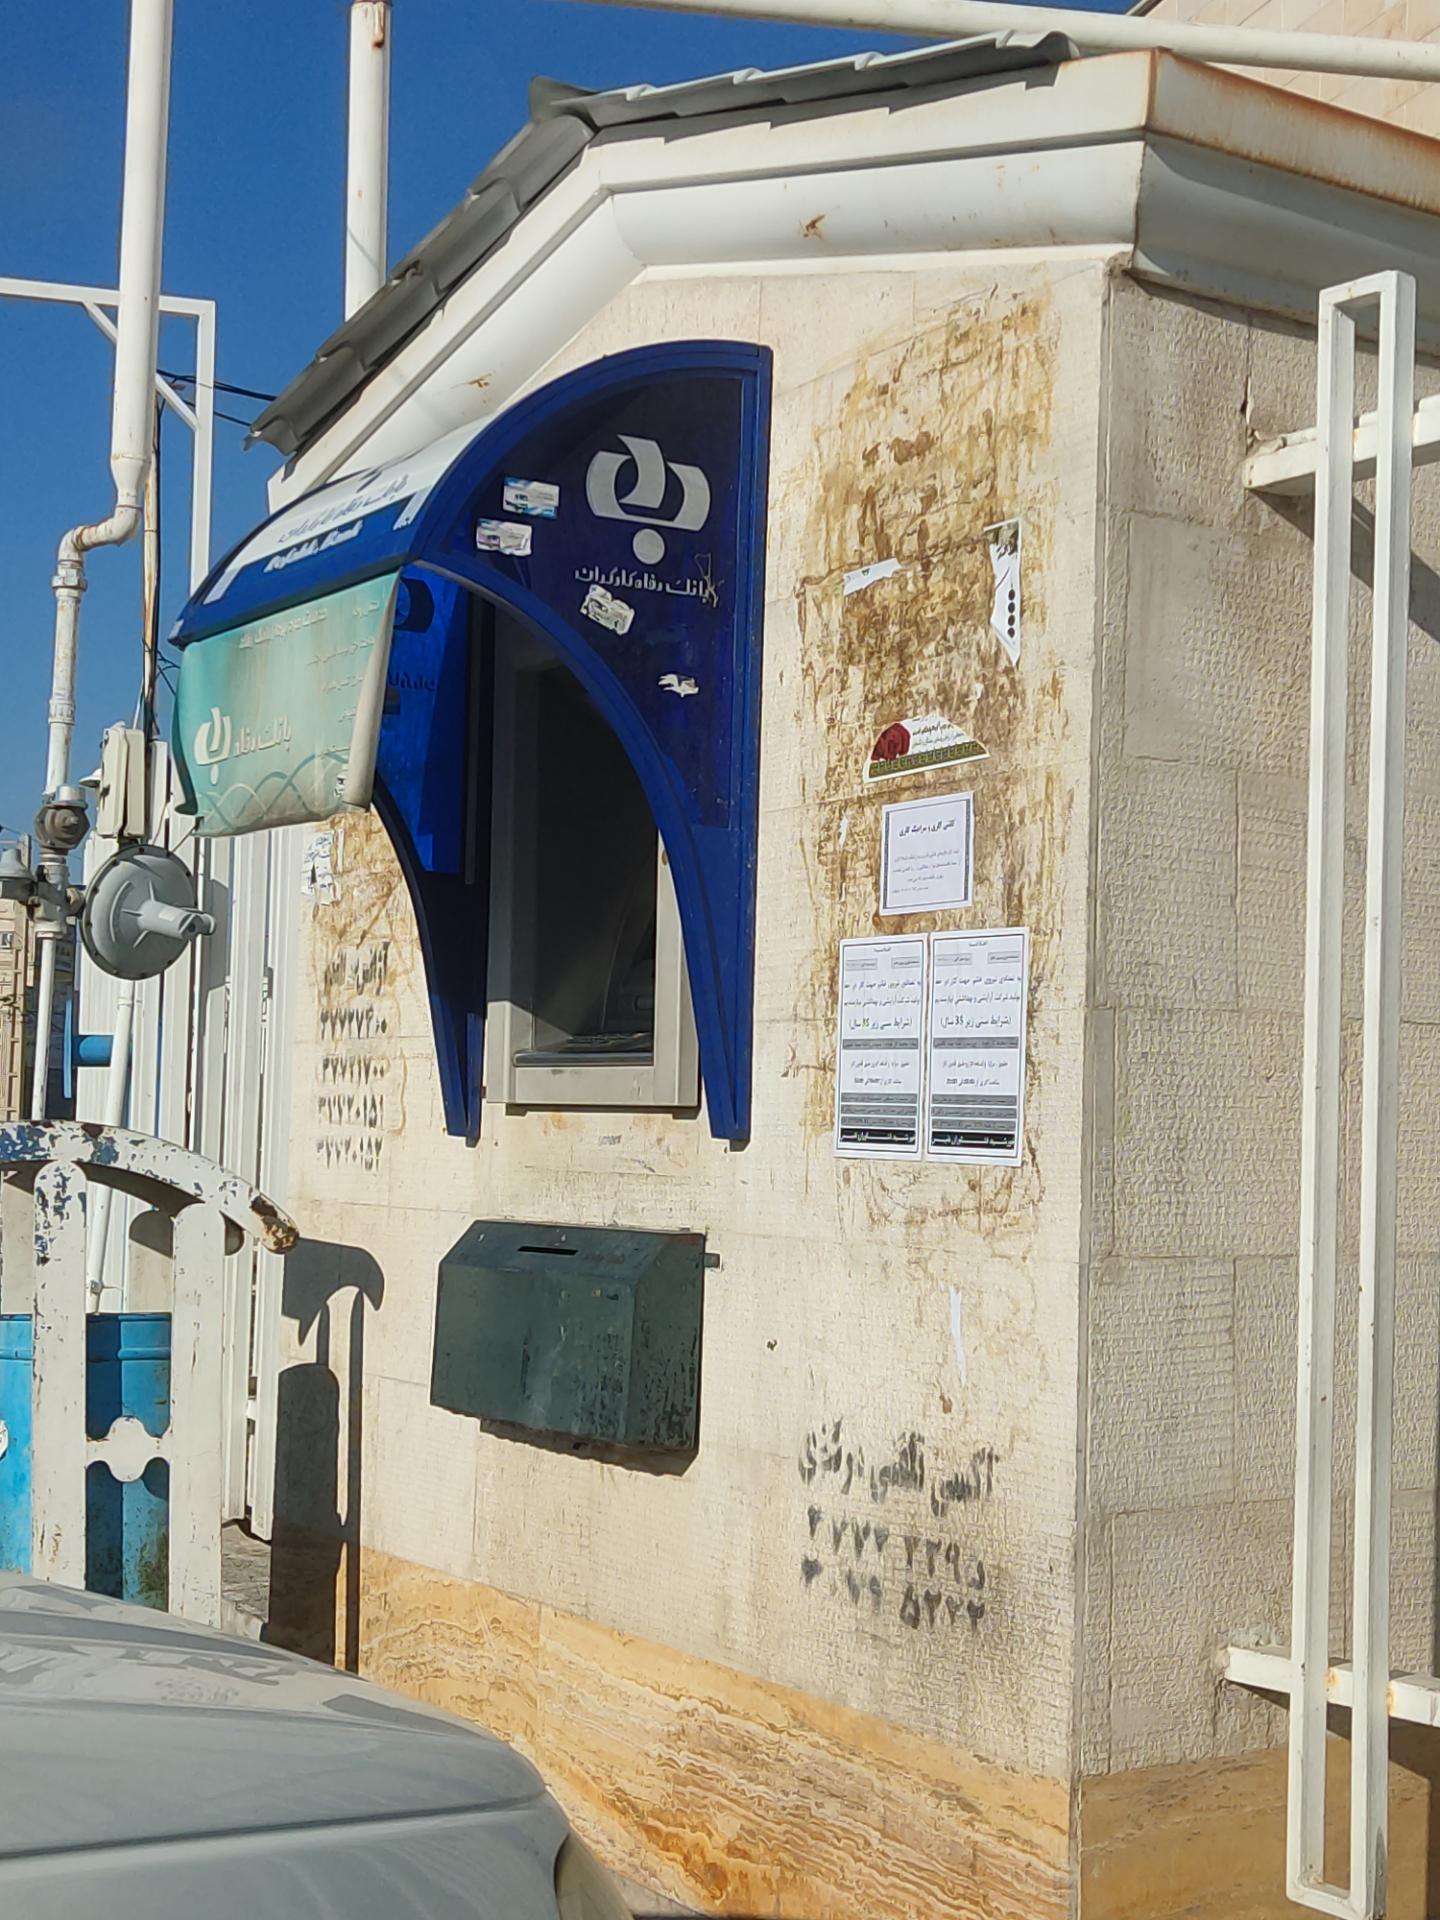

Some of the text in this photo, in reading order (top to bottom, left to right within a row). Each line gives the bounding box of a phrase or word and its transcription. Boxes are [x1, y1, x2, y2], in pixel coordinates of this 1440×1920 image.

[574, 565, 709, 602] بانک رفاه کارگران
[258, 714, 293, 754] بانک
